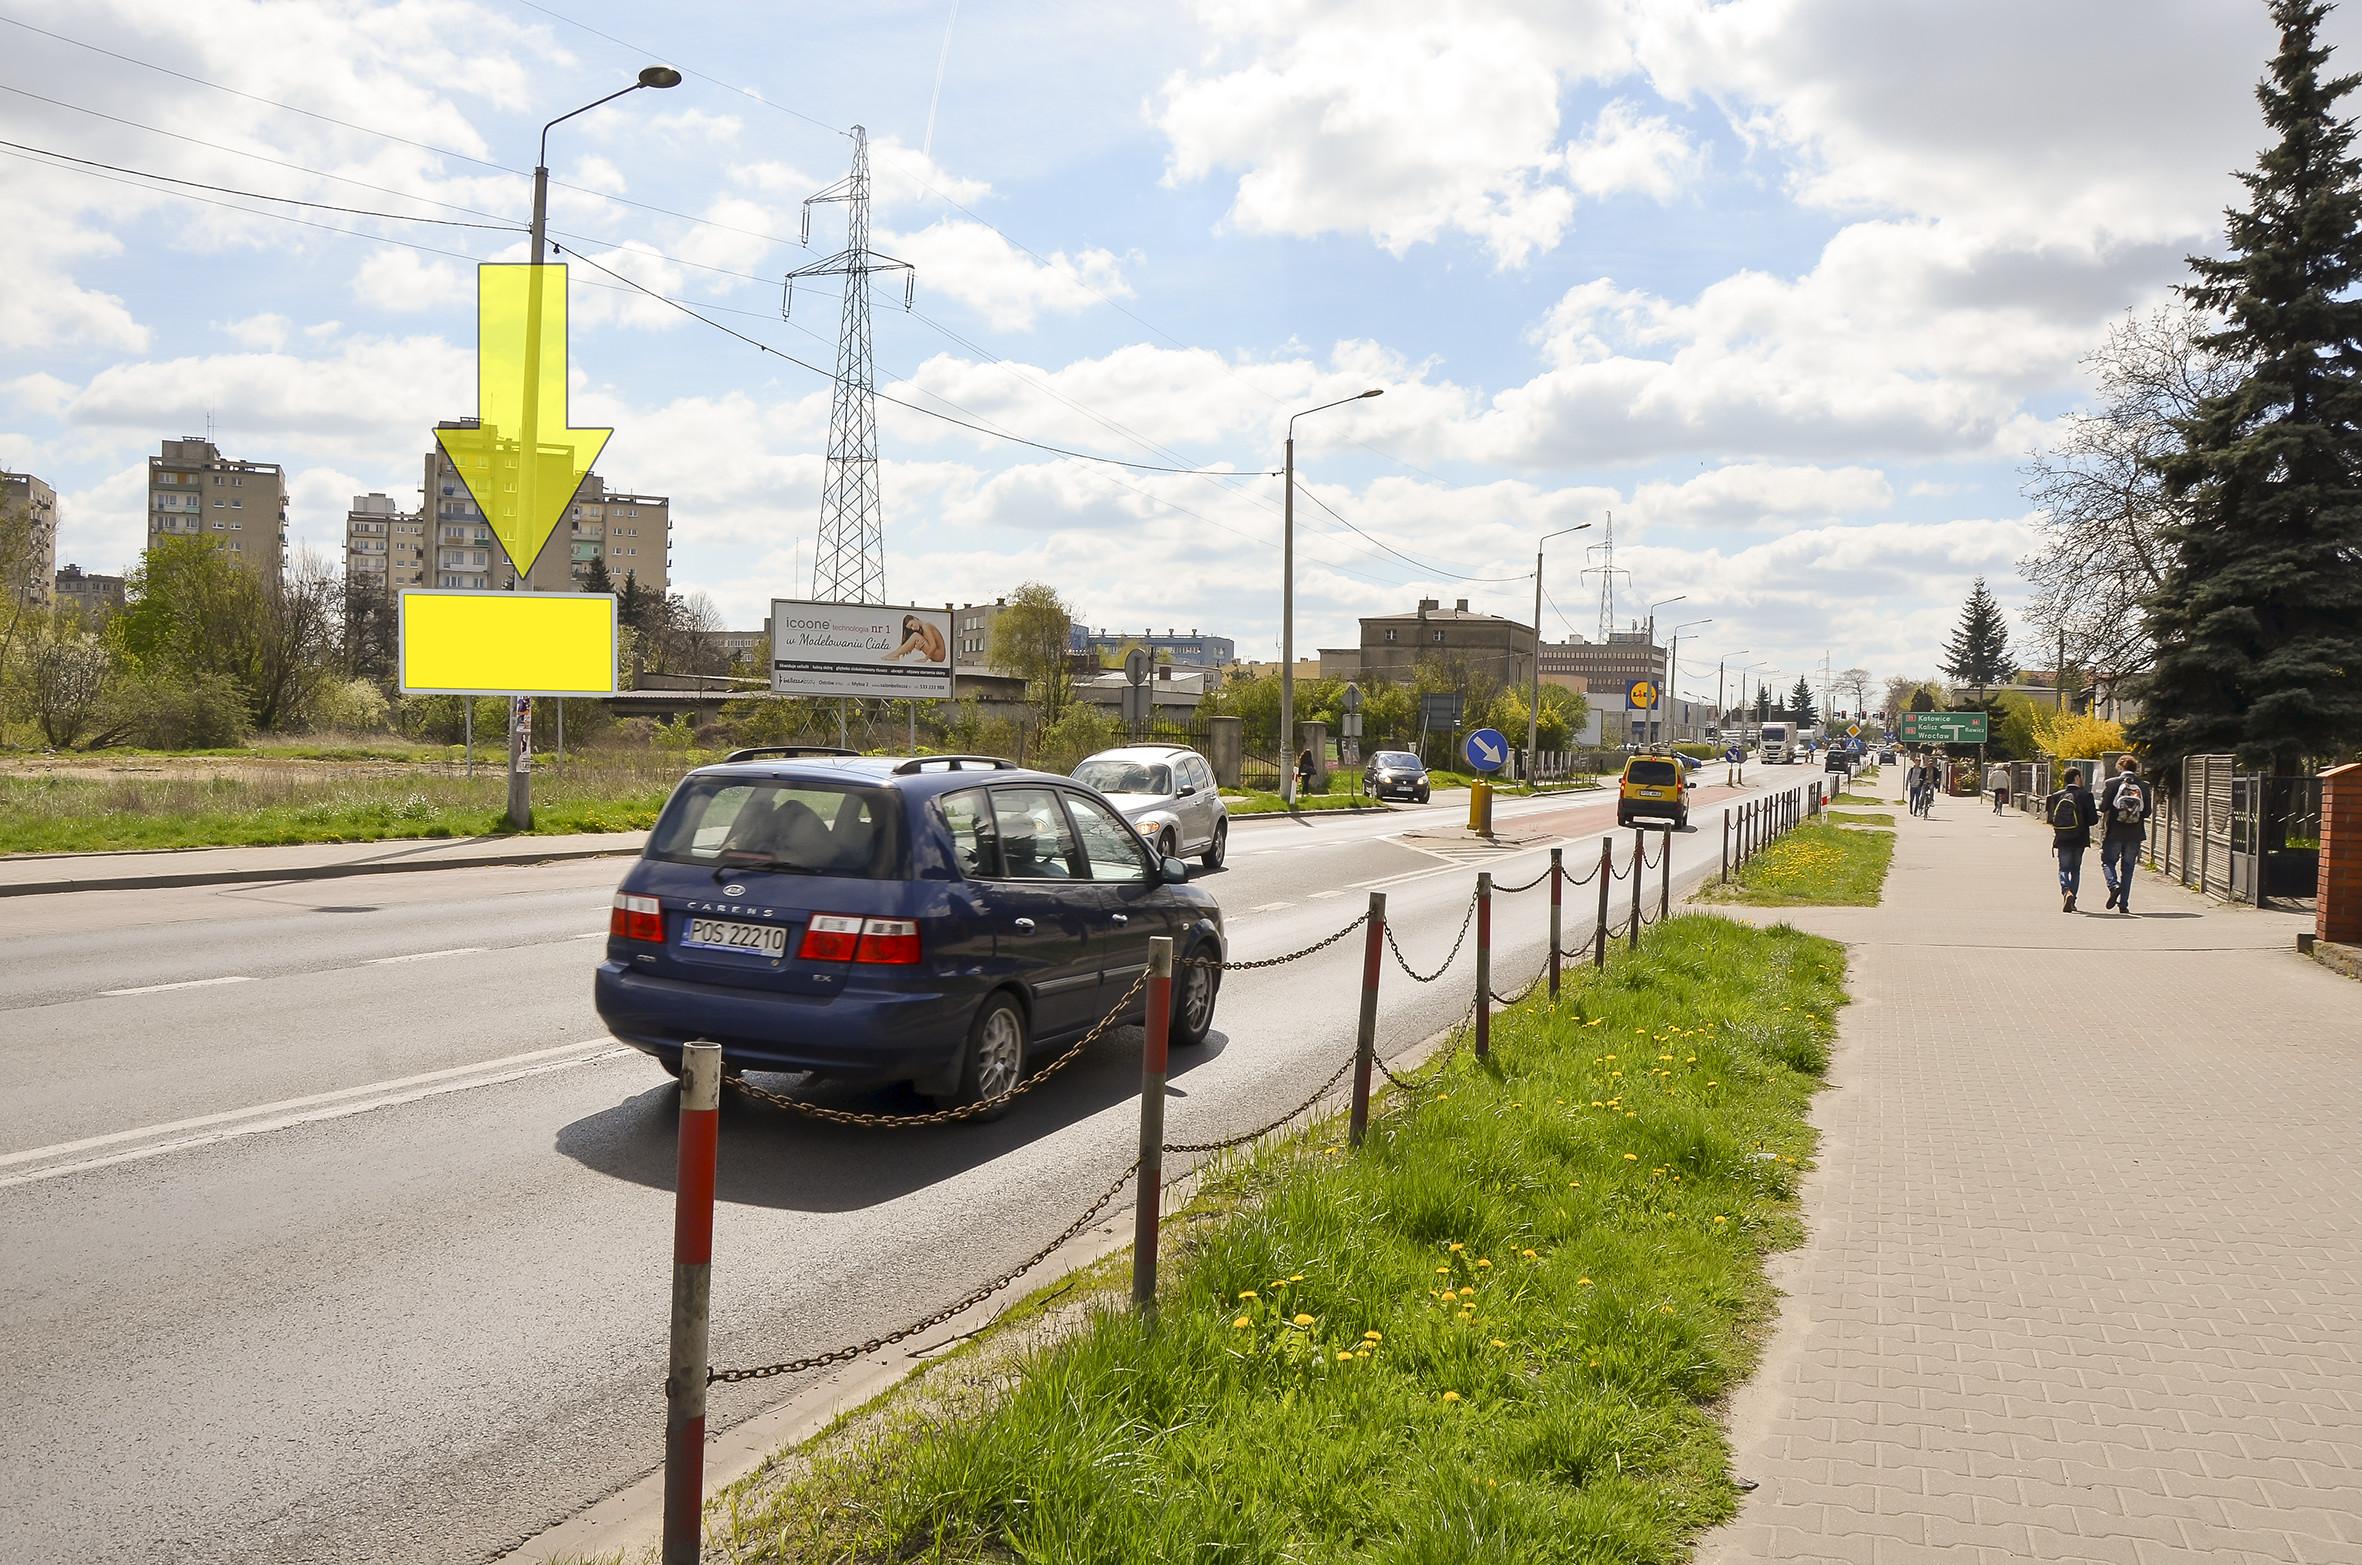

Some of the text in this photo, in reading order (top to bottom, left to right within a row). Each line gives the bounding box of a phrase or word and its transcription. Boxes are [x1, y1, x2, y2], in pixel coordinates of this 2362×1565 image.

[786, 617, 830, 630] icoone
[871, 625, 883, 633] nr
[799, 633, 863, 648] Modelowaniu
[866, 637, 891, 649] Ciała
[687, 902, 774, 917] CARENS
[692, 921, 784, 950] POS 22210
